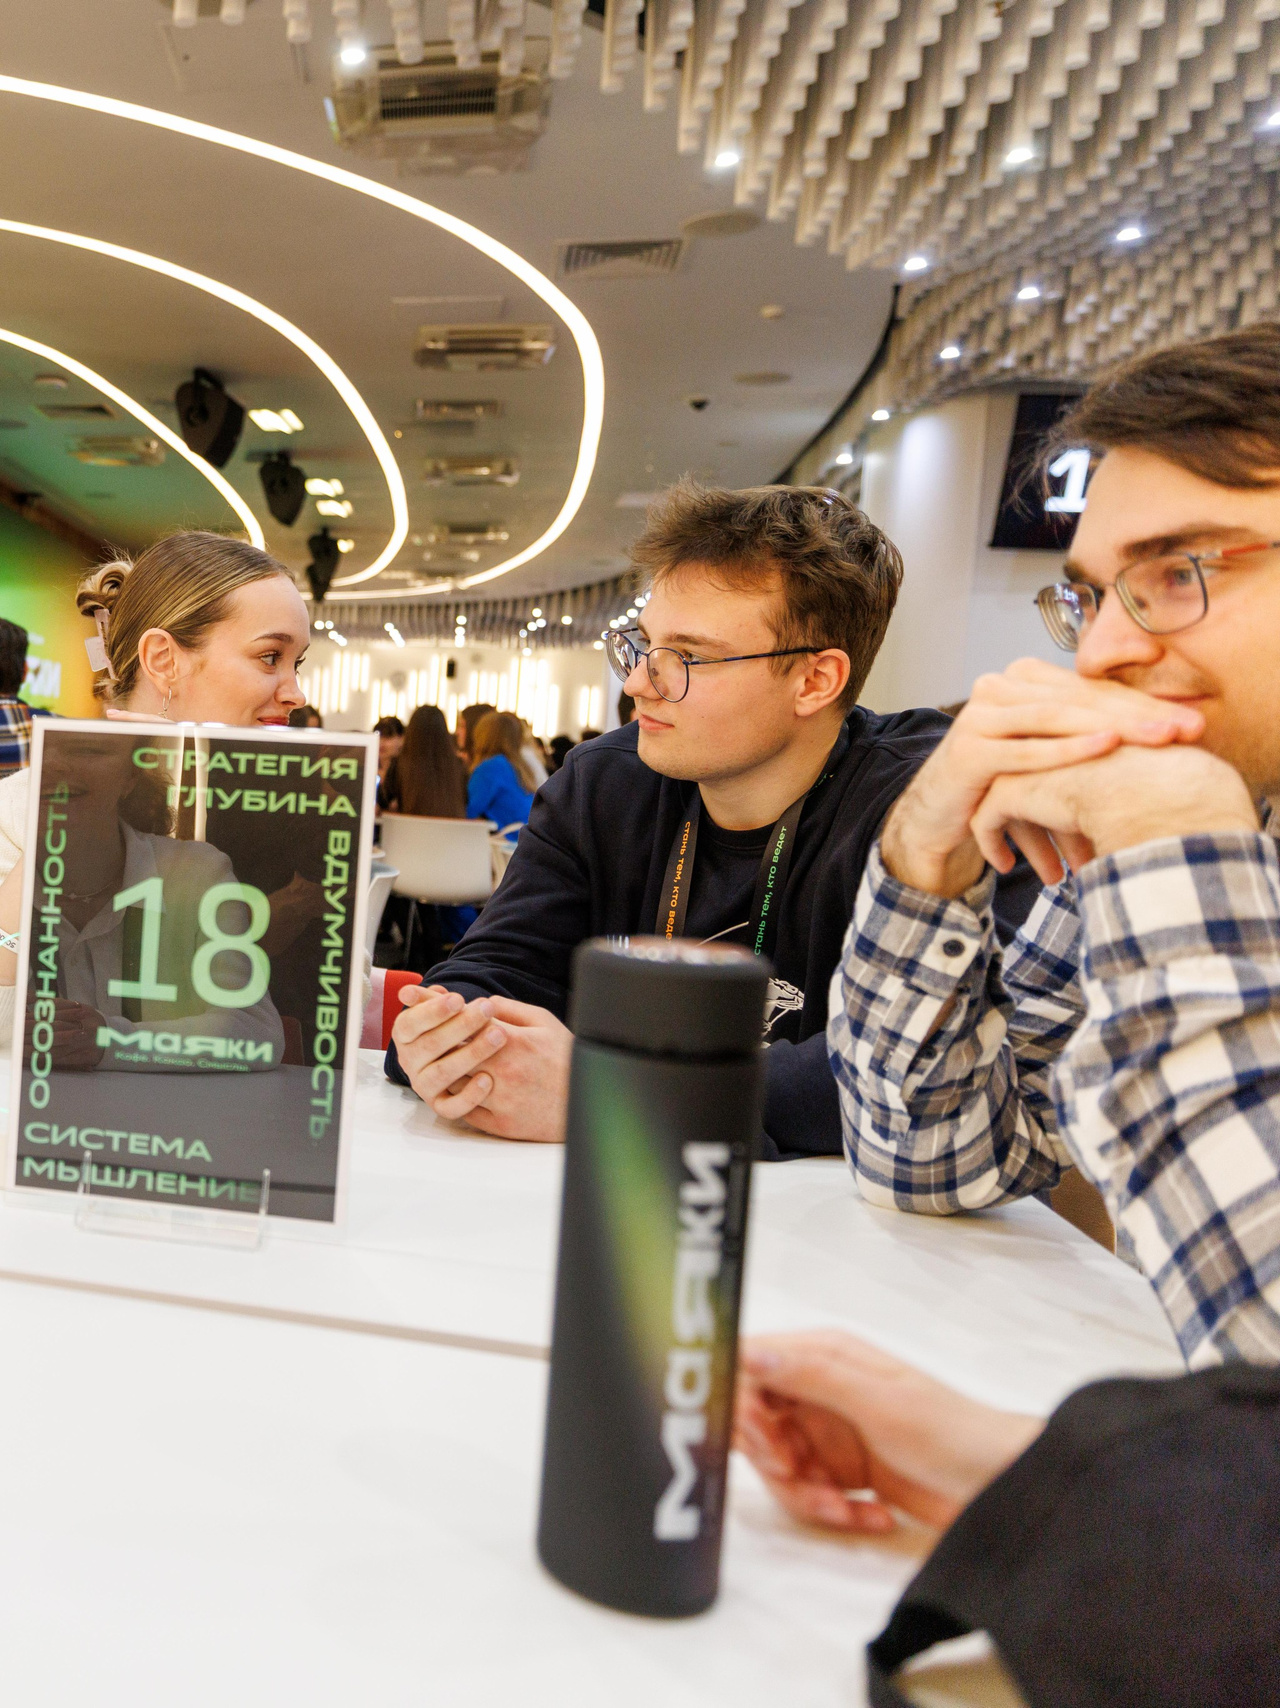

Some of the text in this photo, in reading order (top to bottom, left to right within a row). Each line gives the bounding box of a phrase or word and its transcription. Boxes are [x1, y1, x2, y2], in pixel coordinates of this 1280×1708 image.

[132, 746, 359, 781] СТРАТЕГИЯ
[166, 785, 358, 818] ГЛУБИНА
[665, 821, 691, 940] стань тем, кто веде
[754, 826, 787, 956] стань тем, кто ведет
[28, 781, 70, 1110] ОСОЗНАННОСТЬ
[106, 876, 272, 1010] 18
[308, 829, 352, 1139] ВДУМЧИВОСТЬ
[24, 1121, 213, 1162] СИСТЕМА
